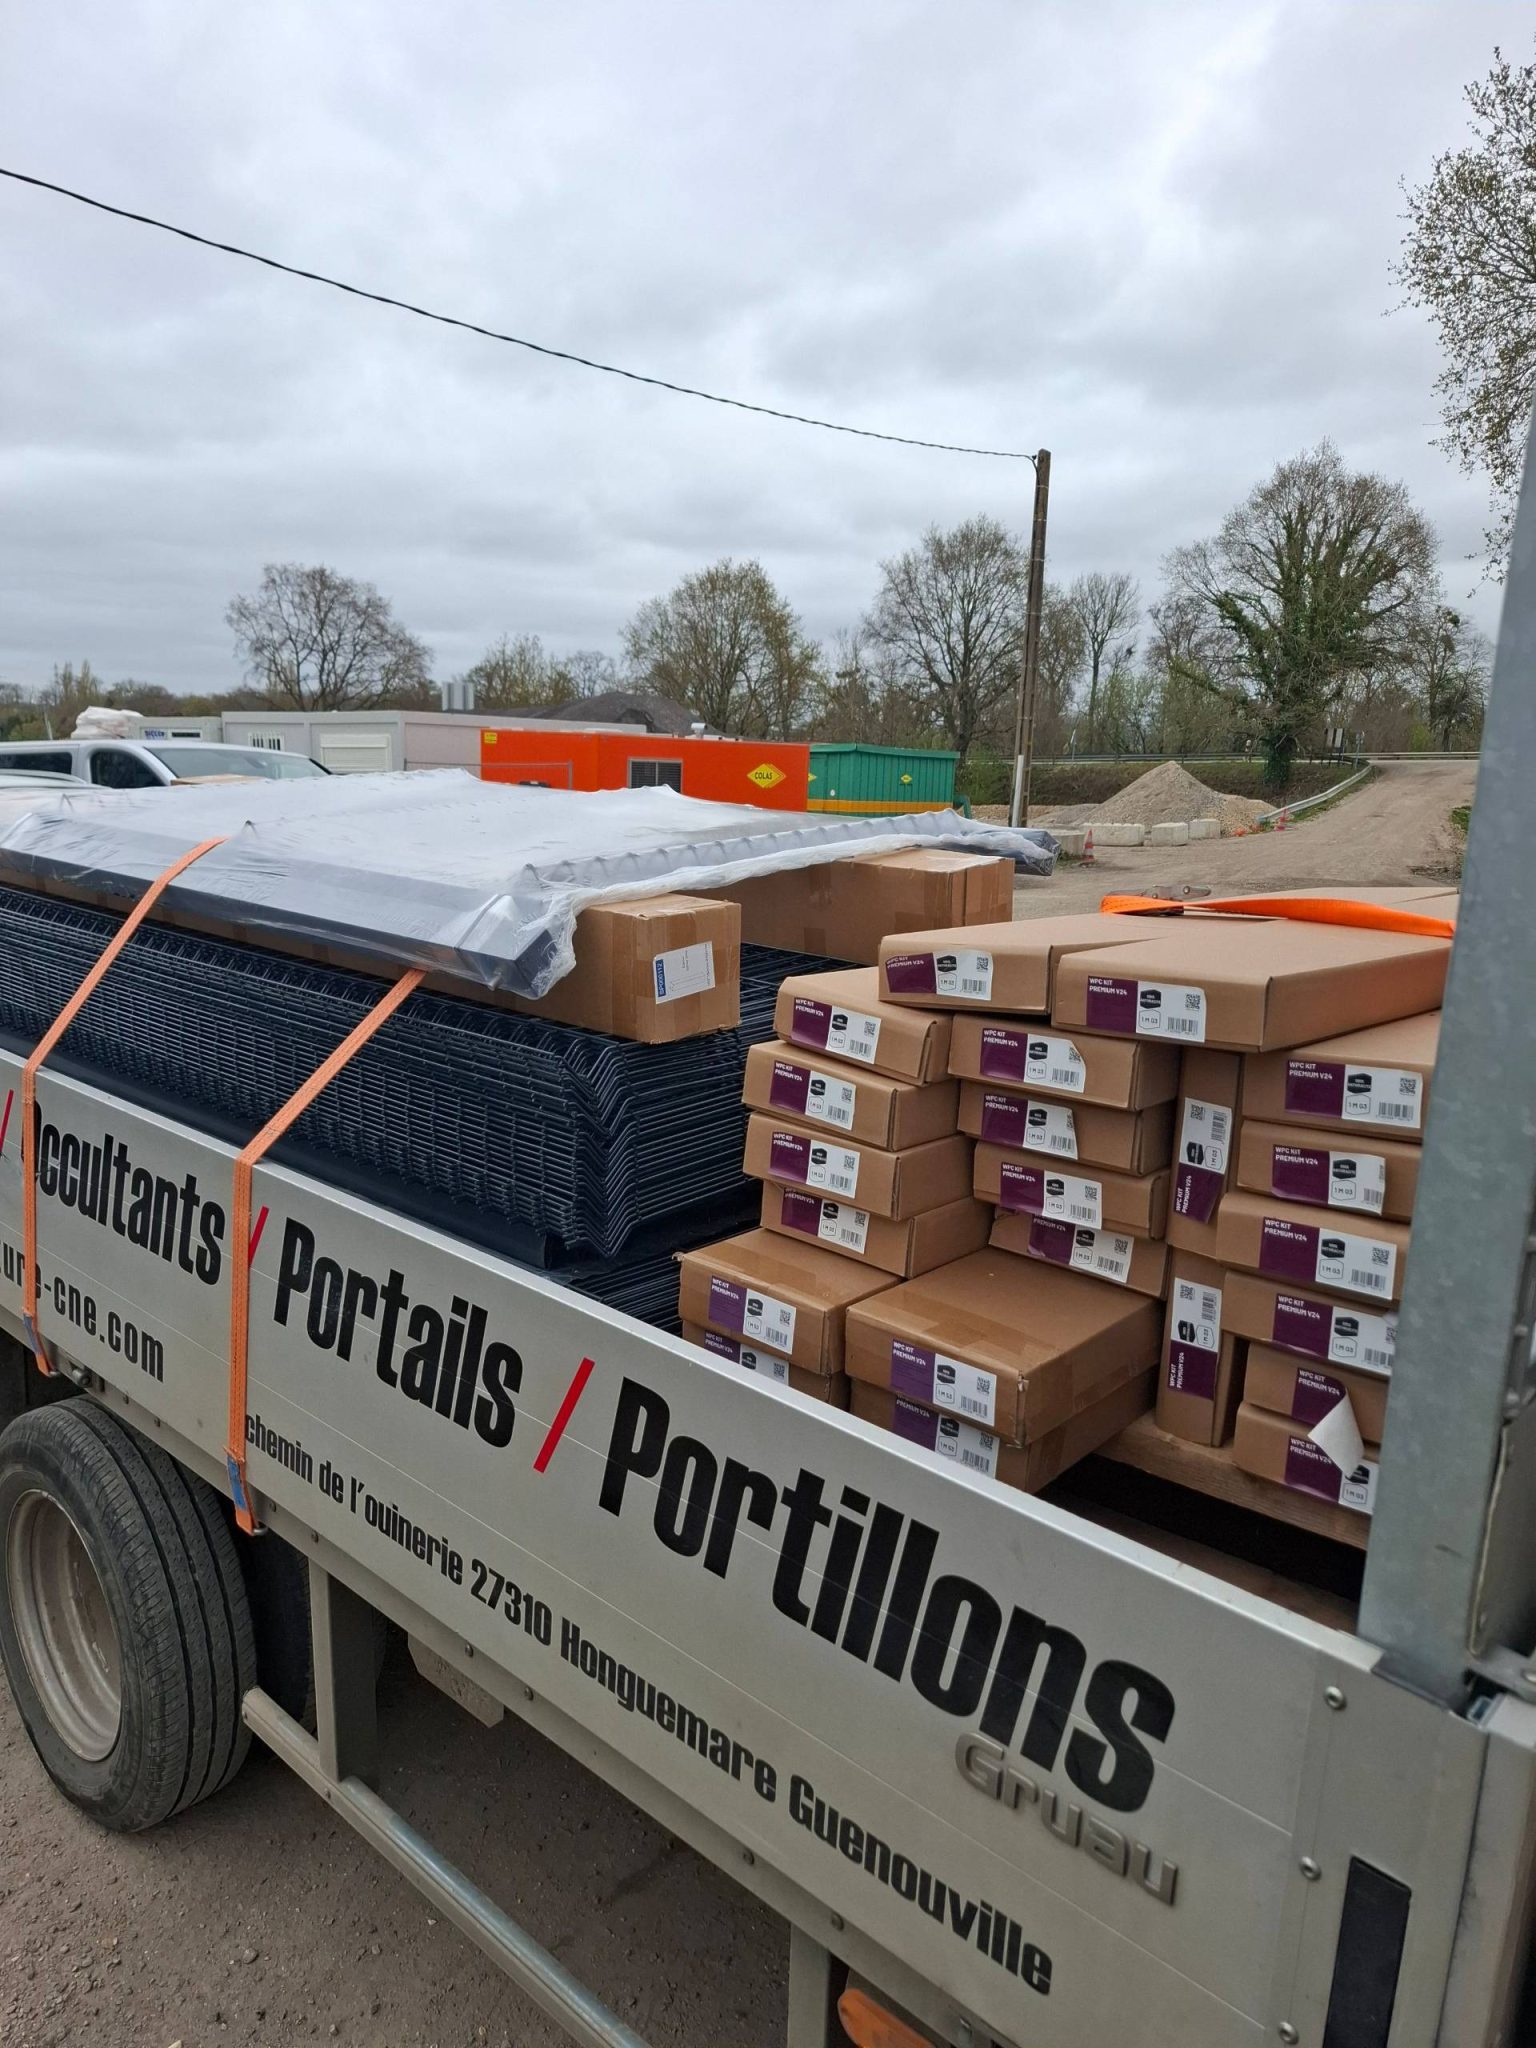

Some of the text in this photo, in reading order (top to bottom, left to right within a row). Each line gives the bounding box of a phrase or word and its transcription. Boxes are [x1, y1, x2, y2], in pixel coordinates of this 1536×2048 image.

[755, 771, 773, 780] COLAS
[1089, 986, 1115, 994] PREMIUM
[795, 1006, 815, 1014] PREMIUM
[984, 1037, 1008, 1045] PREMIUM
[775, 1069, 794, 1079] PREMIUM
[1289, 1070, 1332, 1080] PREMIUM V24
[985, 1102, 1008, 1111] PREMIUM
[774, 1140, 794, 1149] PREMIUM
[1276, 1155, 1304, 1164] PREMIUM
[1003, 1171, 1025, 1180] PREMIUM
[1264, 1228, 1294, 1238] PREMIUM
[712, 1285, 731, 1297] PREMIUM
[1278, 1296, 1292, 1304] WPC
[1278, 1304, 1320, 1319] PREMIUM V24
[894, 1342, 905, 1351] WPC
[893, 1349, 926, 1366] PREMIUM V24
[1300, 1370, 1325, 1382] WPC KIT
[1299, 1378, 1340, 1395] PREMIUM V24
[1291, 1438, 1316, 1451] WPC KIT
[1290, 1446, 1332, 1464] PREMIUM V24
[273, 1217, 523, 1448] Portails
[598, 1376, 1175, 1813] Portillons
[246, 1414, 313, 1485] chemin
[319, 1460, 344, 1504] de
[470, 1558, 552, 1646] 27310
[560, 1616, 777, 1803] Honguemare
[788, 1773, 1053, 1996] Guenouville
[955, 1731, 1180, 1906] Gruau
